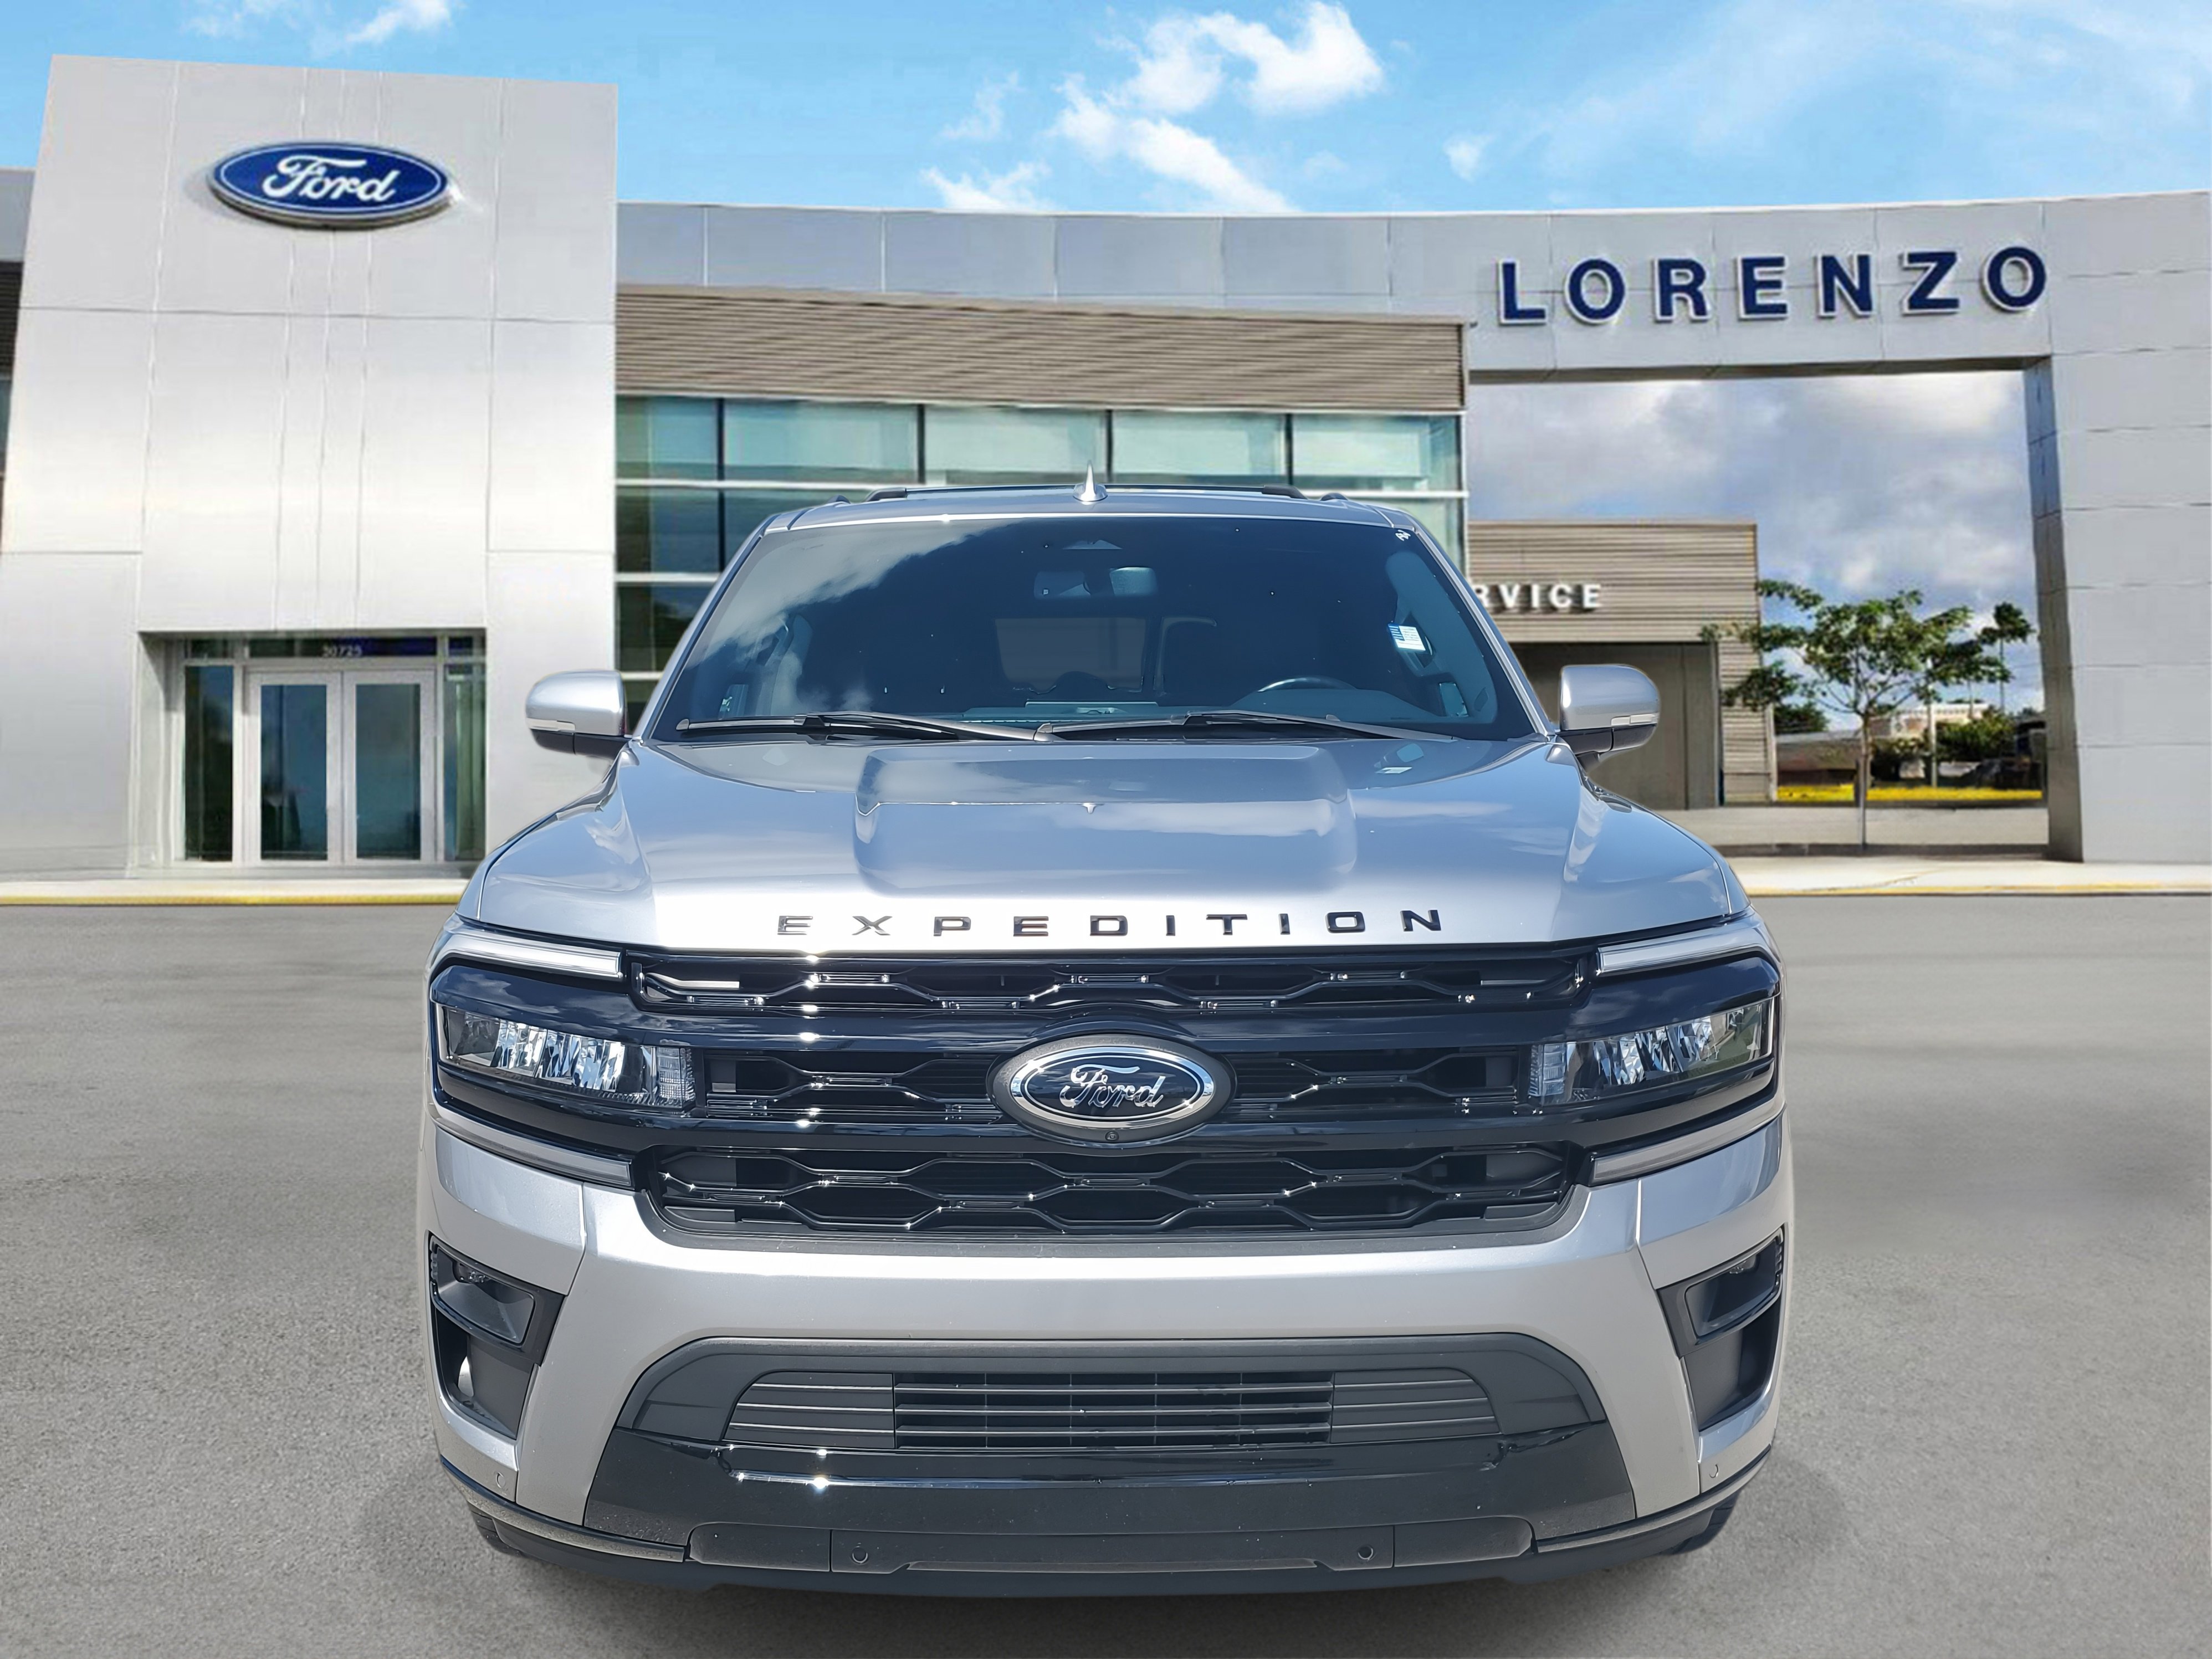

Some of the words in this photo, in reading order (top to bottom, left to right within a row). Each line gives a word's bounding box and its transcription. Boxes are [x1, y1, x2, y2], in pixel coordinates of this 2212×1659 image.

[262, 155, 400, 201] Ford
[1498, 246, 2047, 325] LORENZO
[777, 909, 1442, 937] EXPEDITION
[1059, 1064, 1166, 1108] Ford
